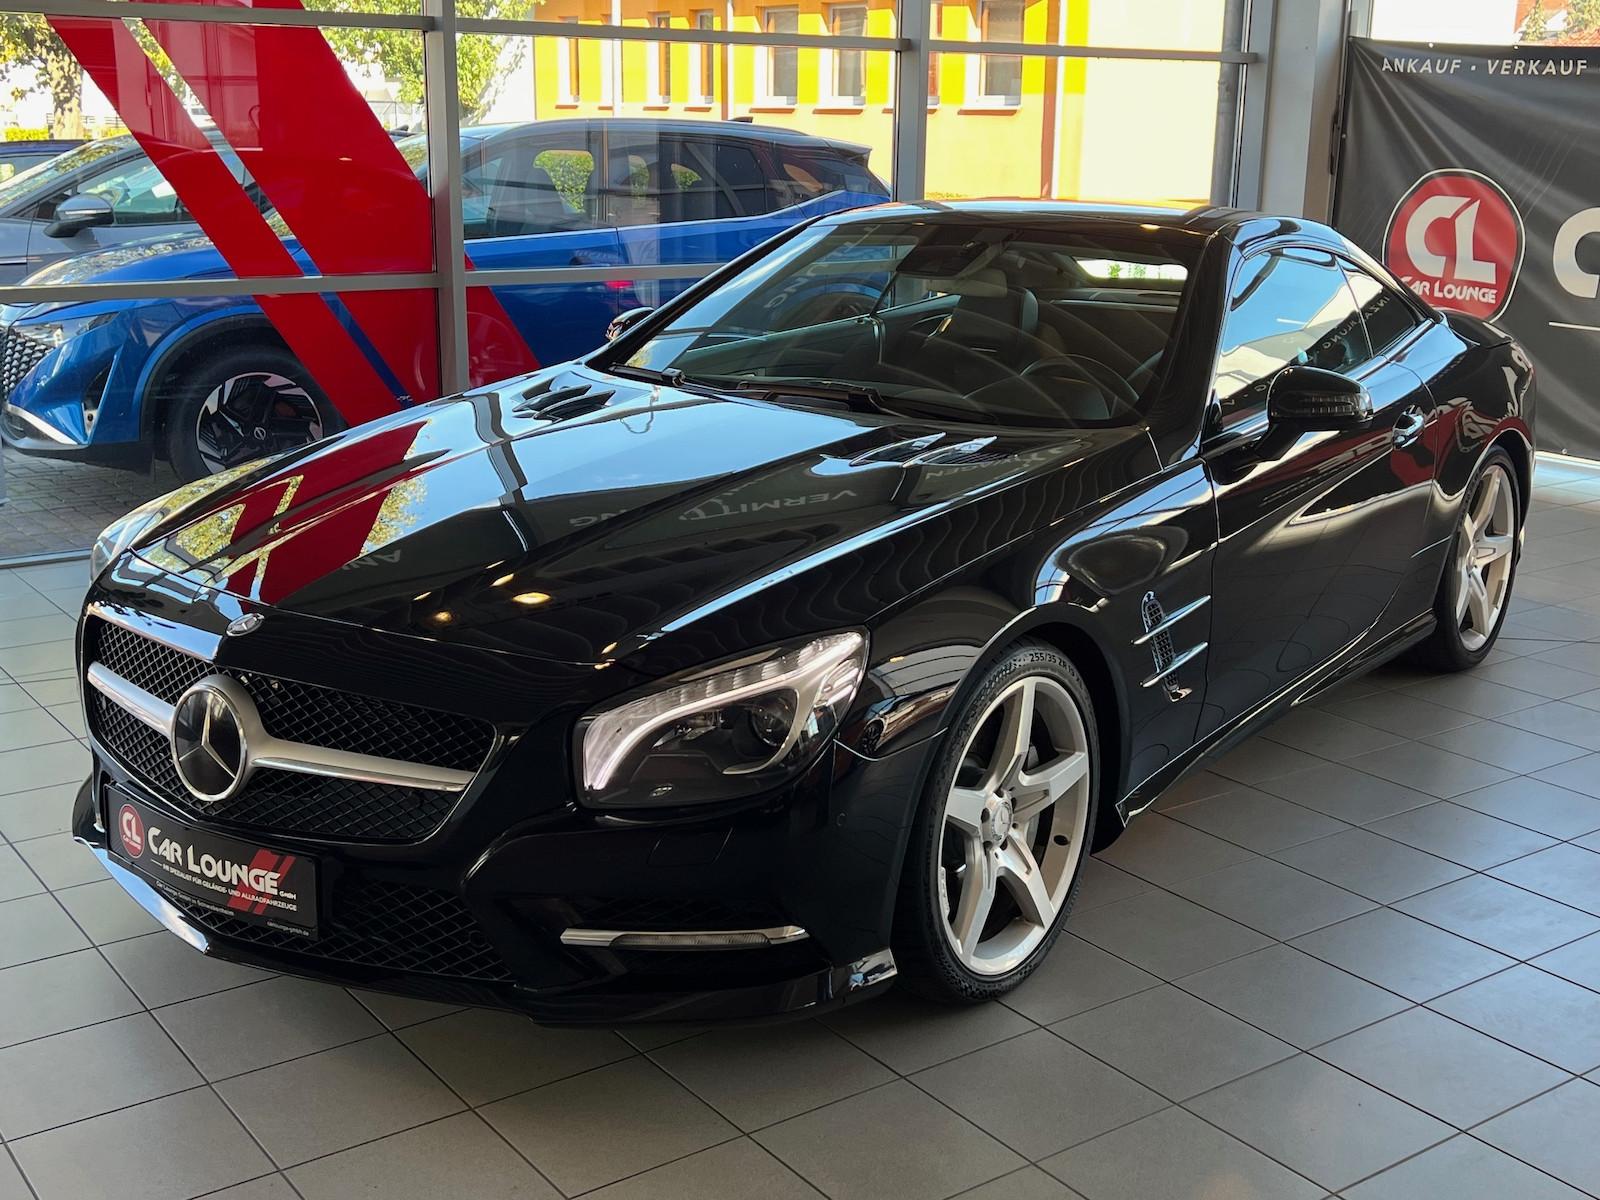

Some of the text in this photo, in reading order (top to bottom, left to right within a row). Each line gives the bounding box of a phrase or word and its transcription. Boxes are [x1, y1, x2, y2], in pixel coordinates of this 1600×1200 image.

[1381, 56, 1588, 76] ANKAUF VERKAUF
[1405, 194, 1497, 284] CL
[1433, 279, 1498, 305] LOUNGE
[122, 811, 142, 845] CL
[147, 826, 183, 867] CAR
[186, 844, 281, 896] LOUNGE
